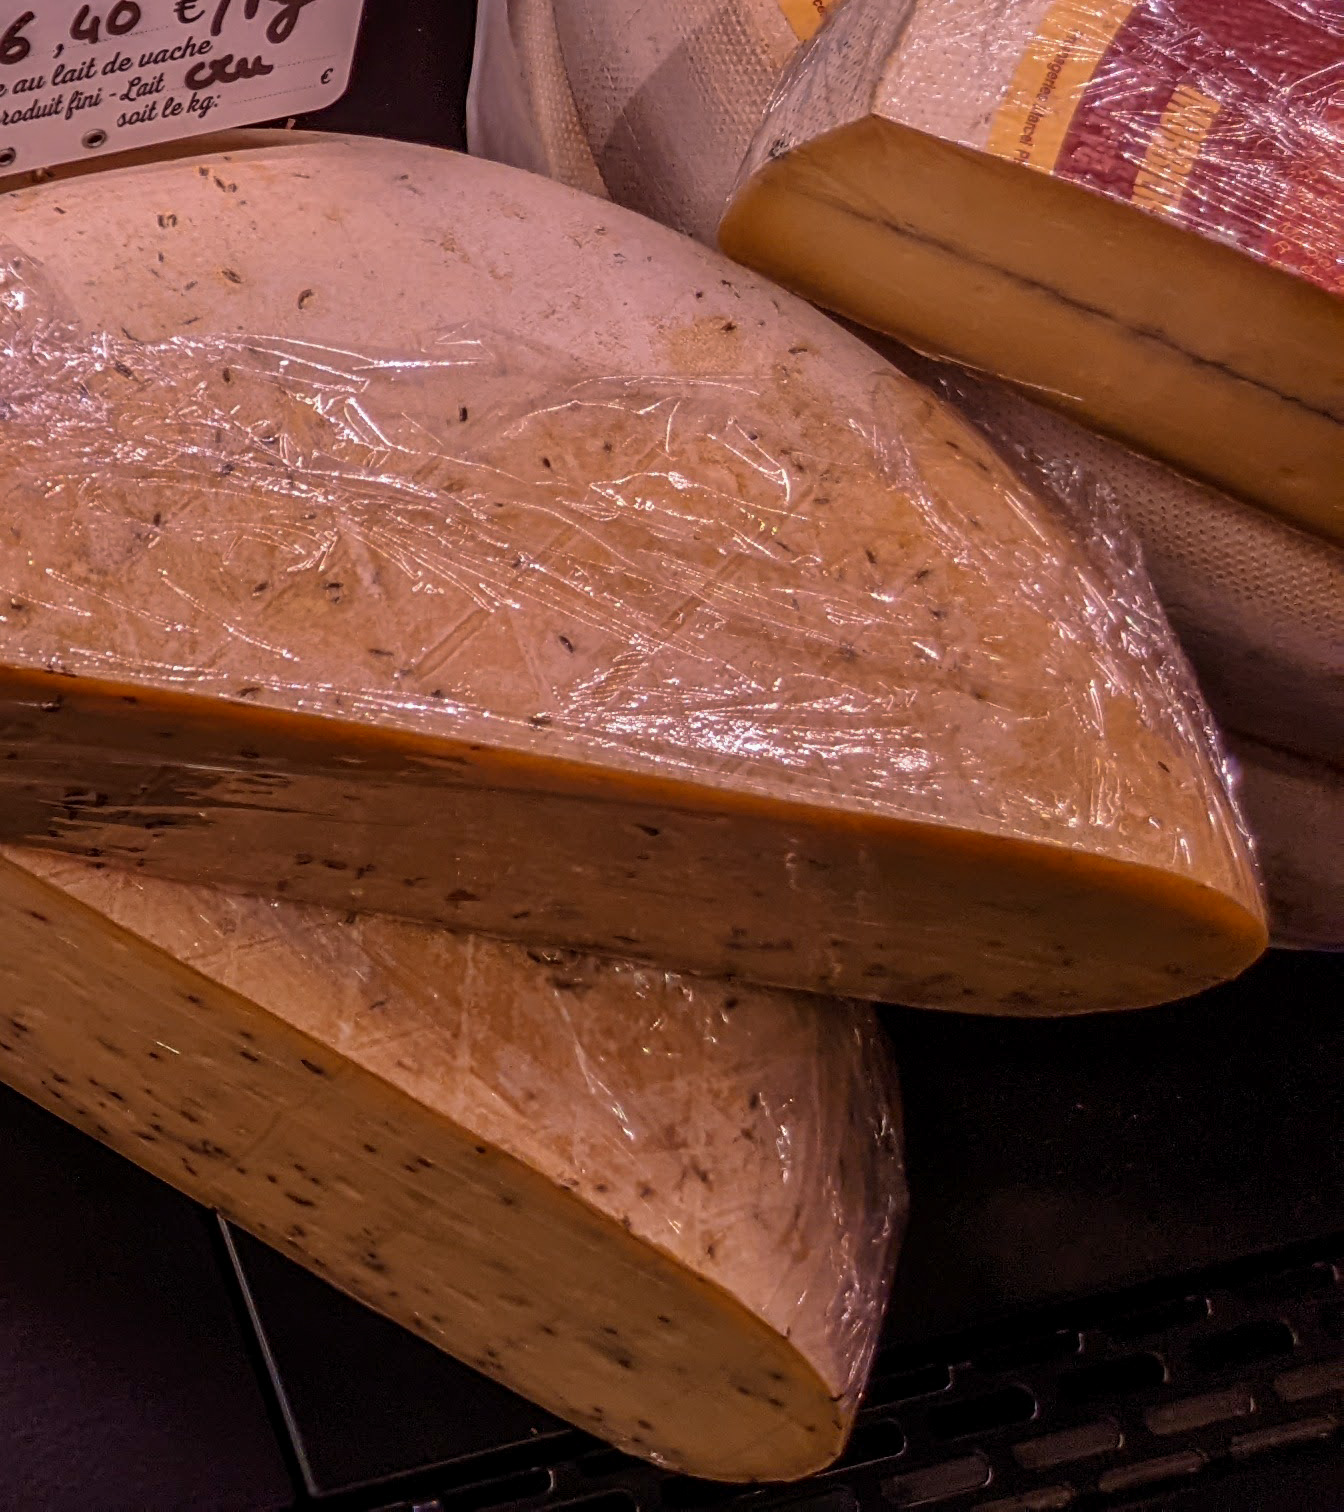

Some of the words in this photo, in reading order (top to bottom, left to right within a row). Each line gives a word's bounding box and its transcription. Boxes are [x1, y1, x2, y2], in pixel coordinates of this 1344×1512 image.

[12, 75, 46, 93] au
[51, 61, 98, 87] lait
[101, 53, 136, 76] de
[138, 38, 214, 68] vache
[65, 89, 104, 119] fini
[120, 75, 166, 101] Lait
[117, 105, 159, 128] soit
[163, 98, 184, 118] le
